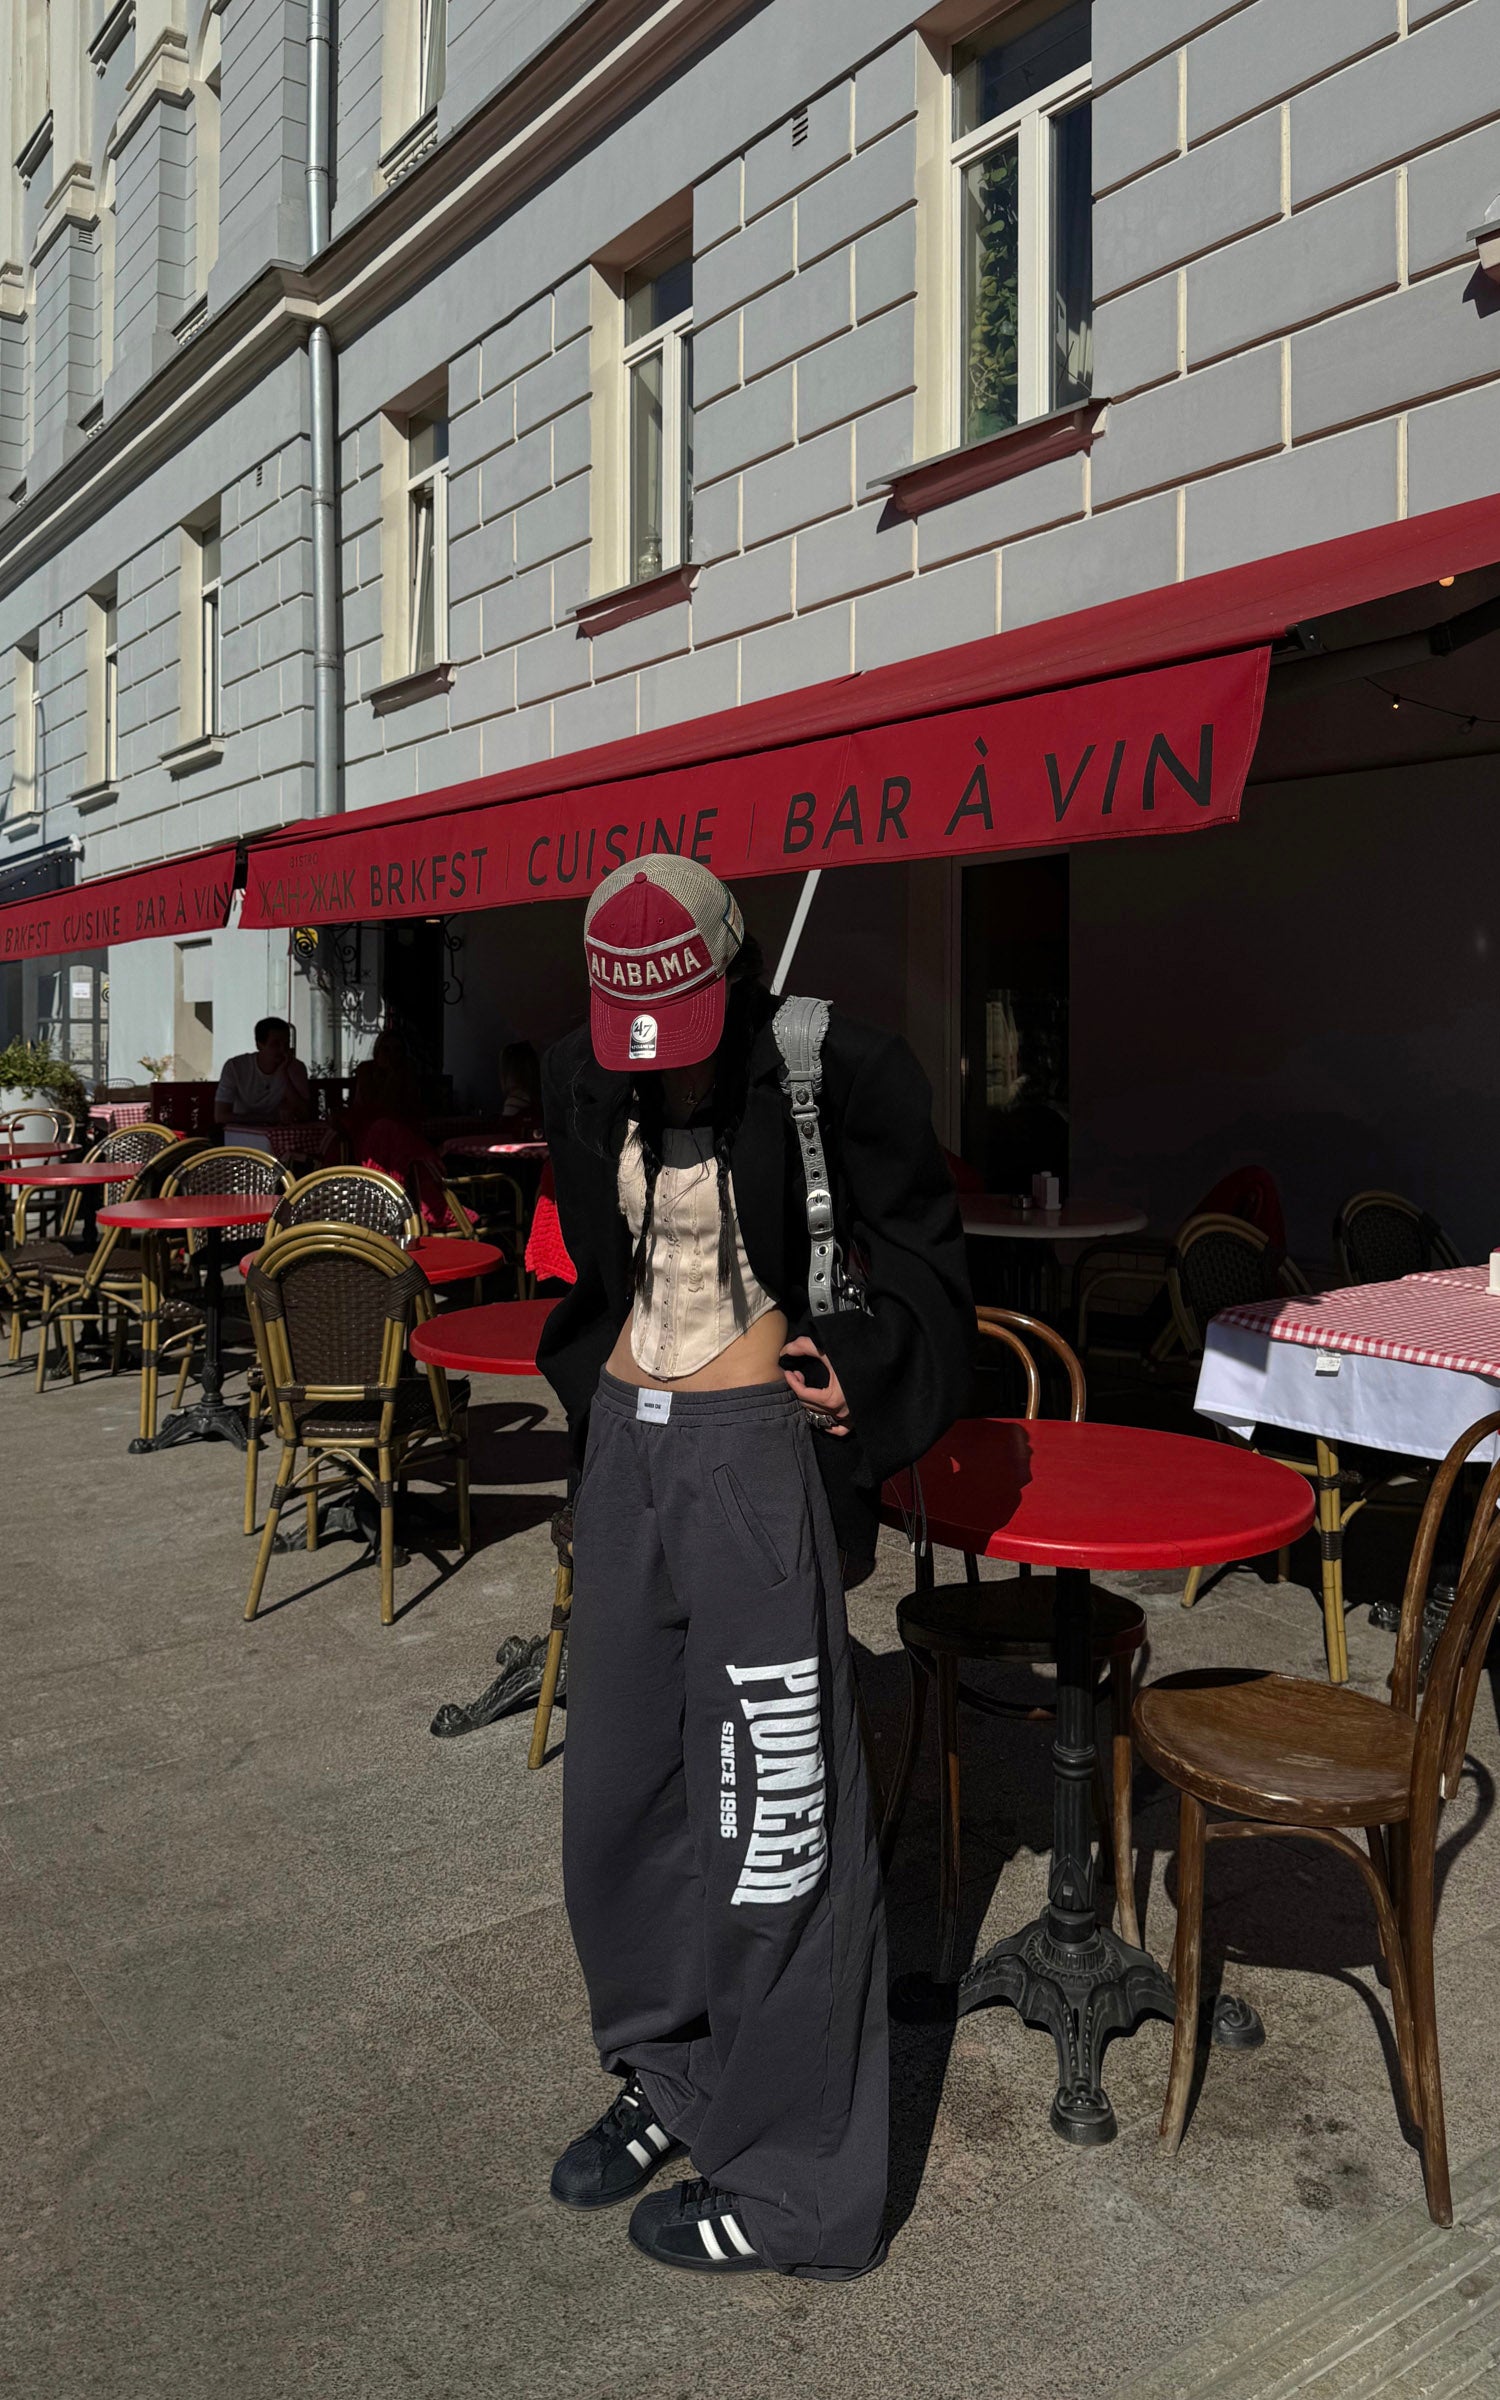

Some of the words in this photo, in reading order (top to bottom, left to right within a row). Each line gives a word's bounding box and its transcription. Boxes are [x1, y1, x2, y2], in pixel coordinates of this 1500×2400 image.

[258, 868, 357, 918] ЖАН-ЖАК
[370, 847, 488, 907] BRKFST
[528, 808, 719, 886] CUISINE
[783, 775, 912, 854] BAR
[943, 736, 994, 836] À
[1044, 723, 1214, 823] VIN
[5, 921, 51, 953] BRKFST
[63, 906, 120, 944] CUISINE
[135, 895, 167, 931] BAR
[174, 880, 187, 925] À
[592, 947, 702, 987] ALABAMA
[720, 1721, 737, 1786] SINCE
[725, 1656, 828, 1906] PIONEER
[720, 1790, 738, 1839] 1996
